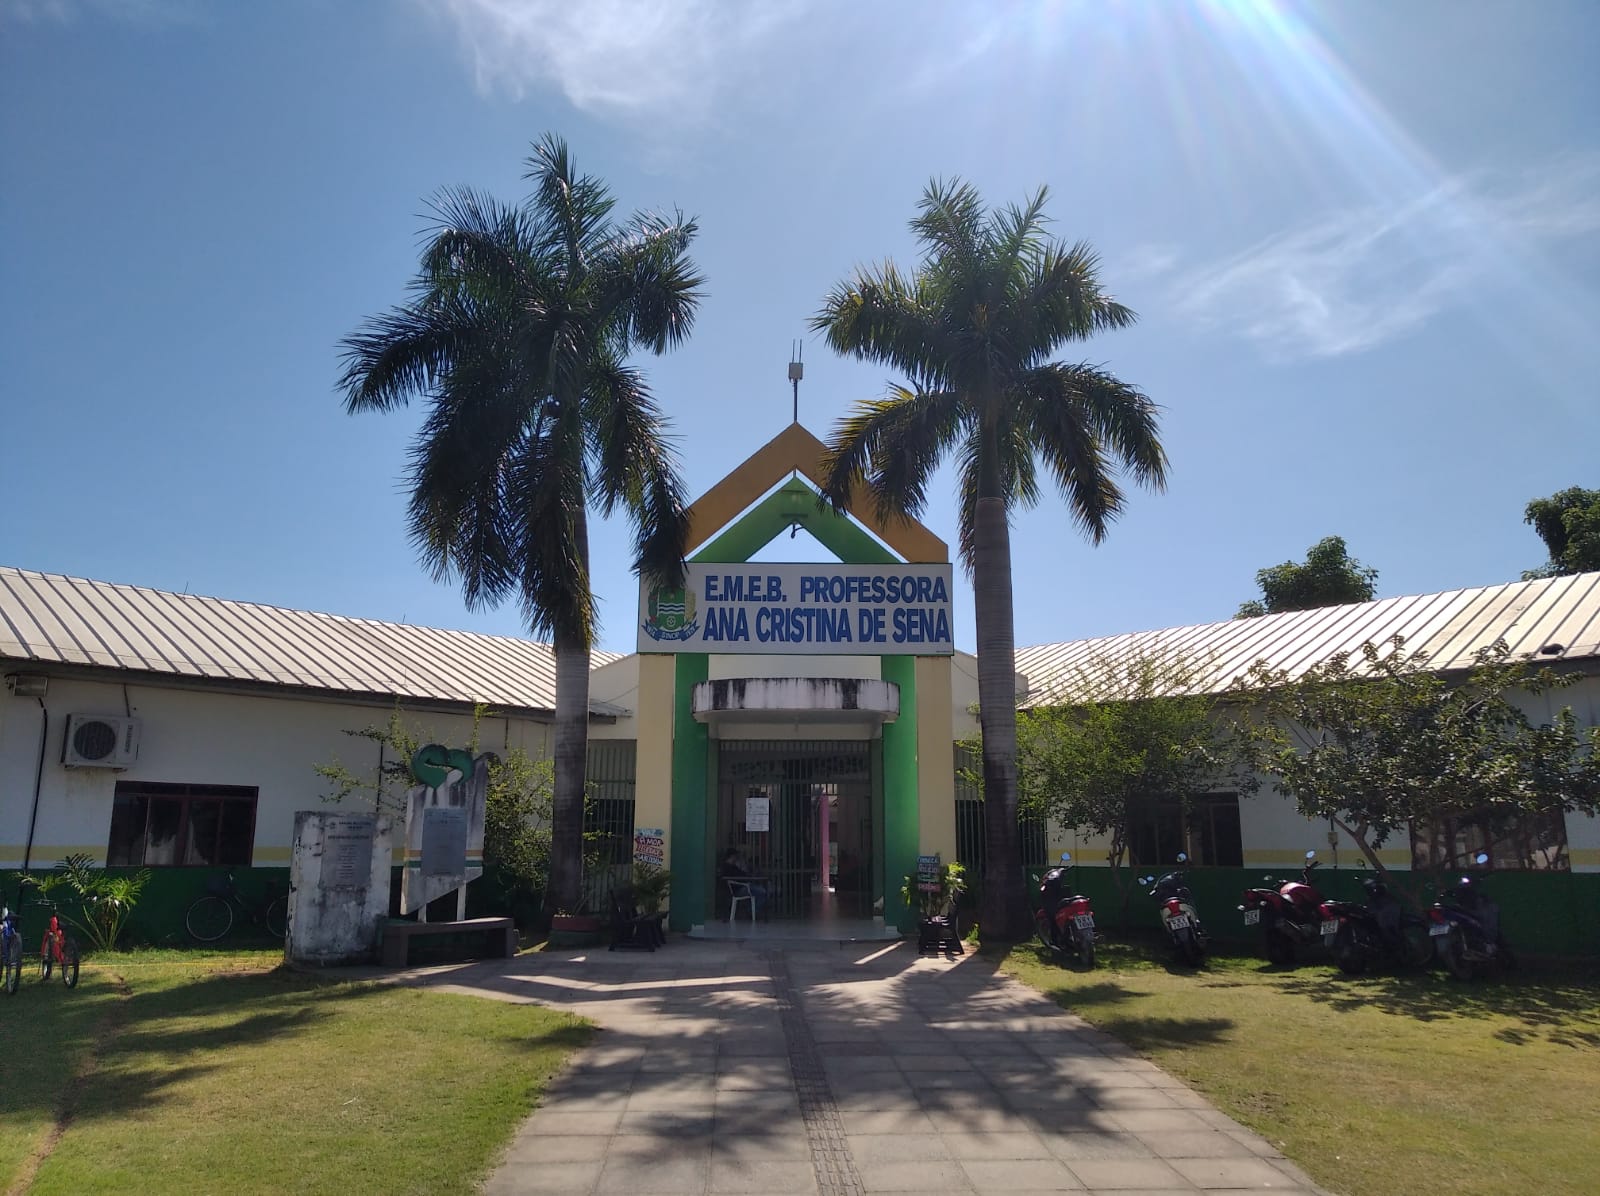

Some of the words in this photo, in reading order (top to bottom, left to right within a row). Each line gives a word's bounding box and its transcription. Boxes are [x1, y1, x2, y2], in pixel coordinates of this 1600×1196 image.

[705, 575, 787, 602] E.M.E.B.
[800, 575, 949, 604] PROFESSORA
[702, 607, 750, 642] ANA
[755, 606, 853, 643] CRISTINA
[858, 607, 887, 643] DE
[892, 607, 951, 643] SENA
